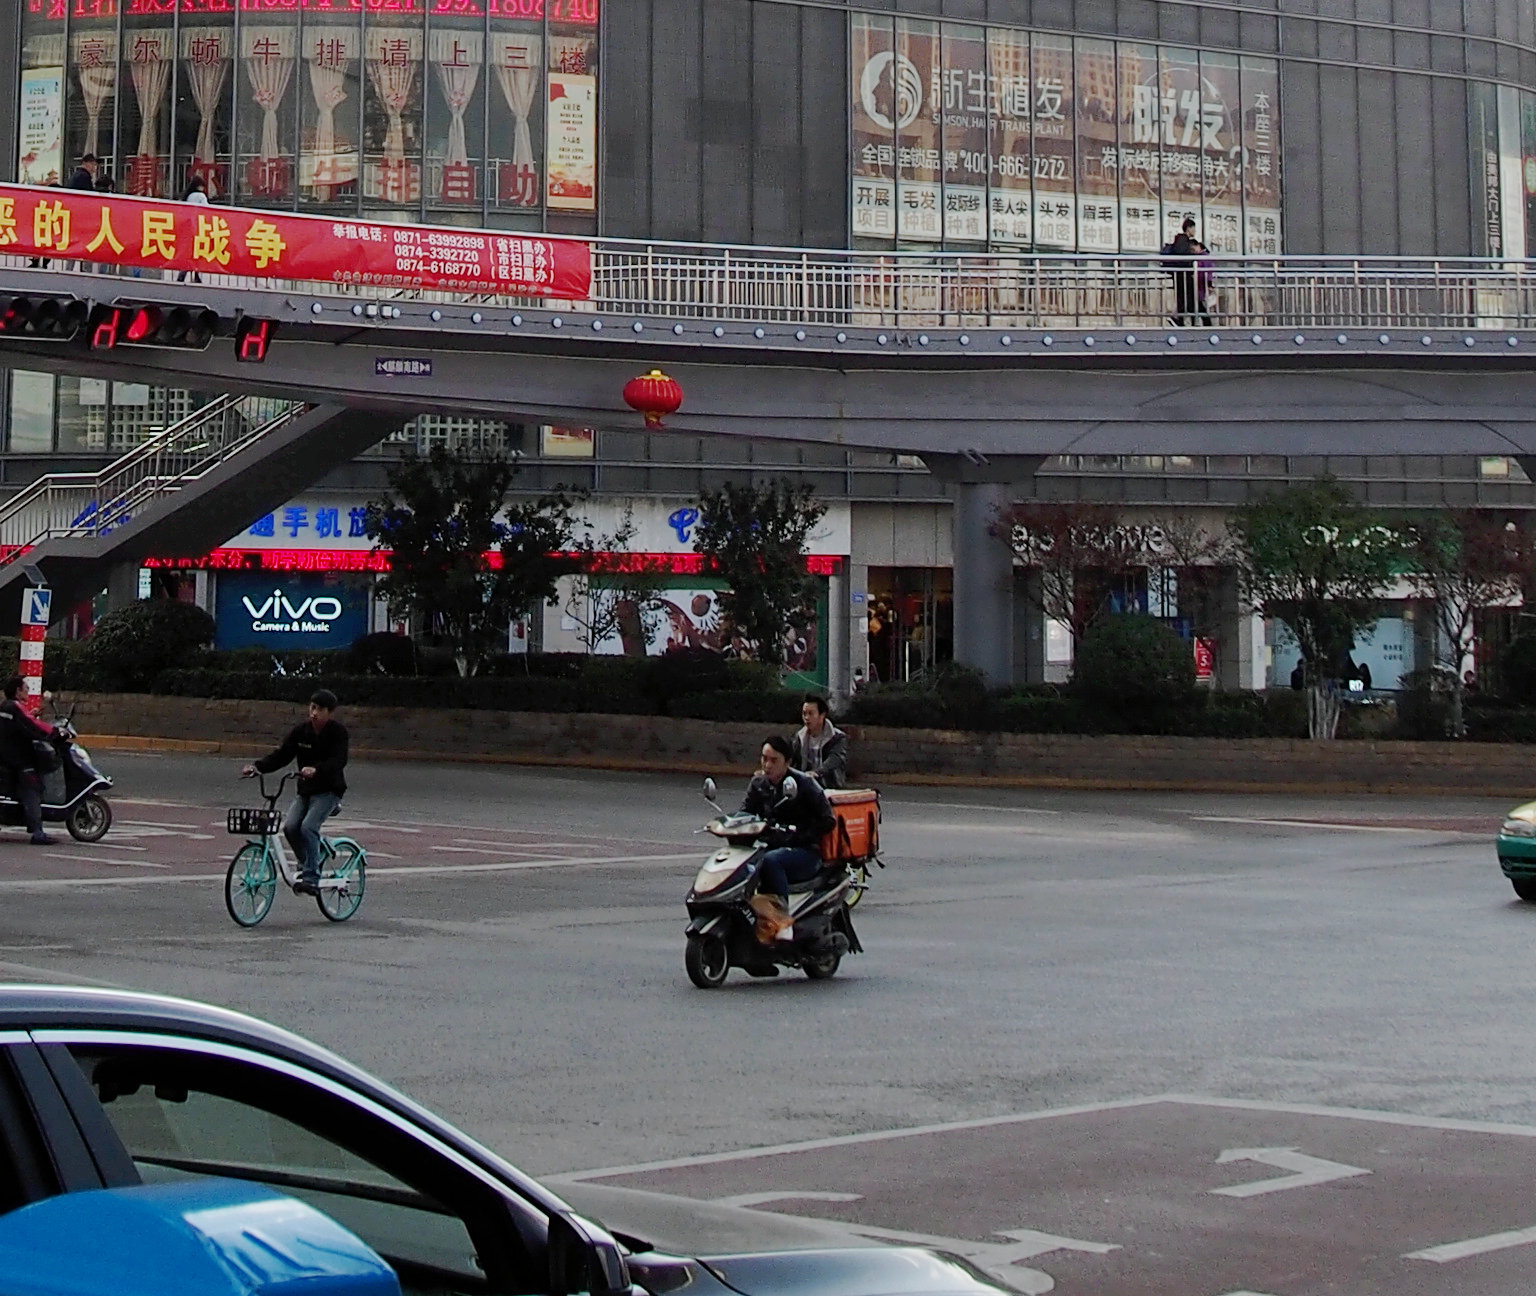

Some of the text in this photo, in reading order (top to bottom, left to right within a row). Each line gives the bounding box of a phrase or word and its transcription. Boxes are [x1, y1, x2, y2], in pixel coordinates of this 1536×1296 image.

[242, 589, 342, 621] vivo
[252, 621, 291, 632] Camera
[301, 622, 330, 633] Music
